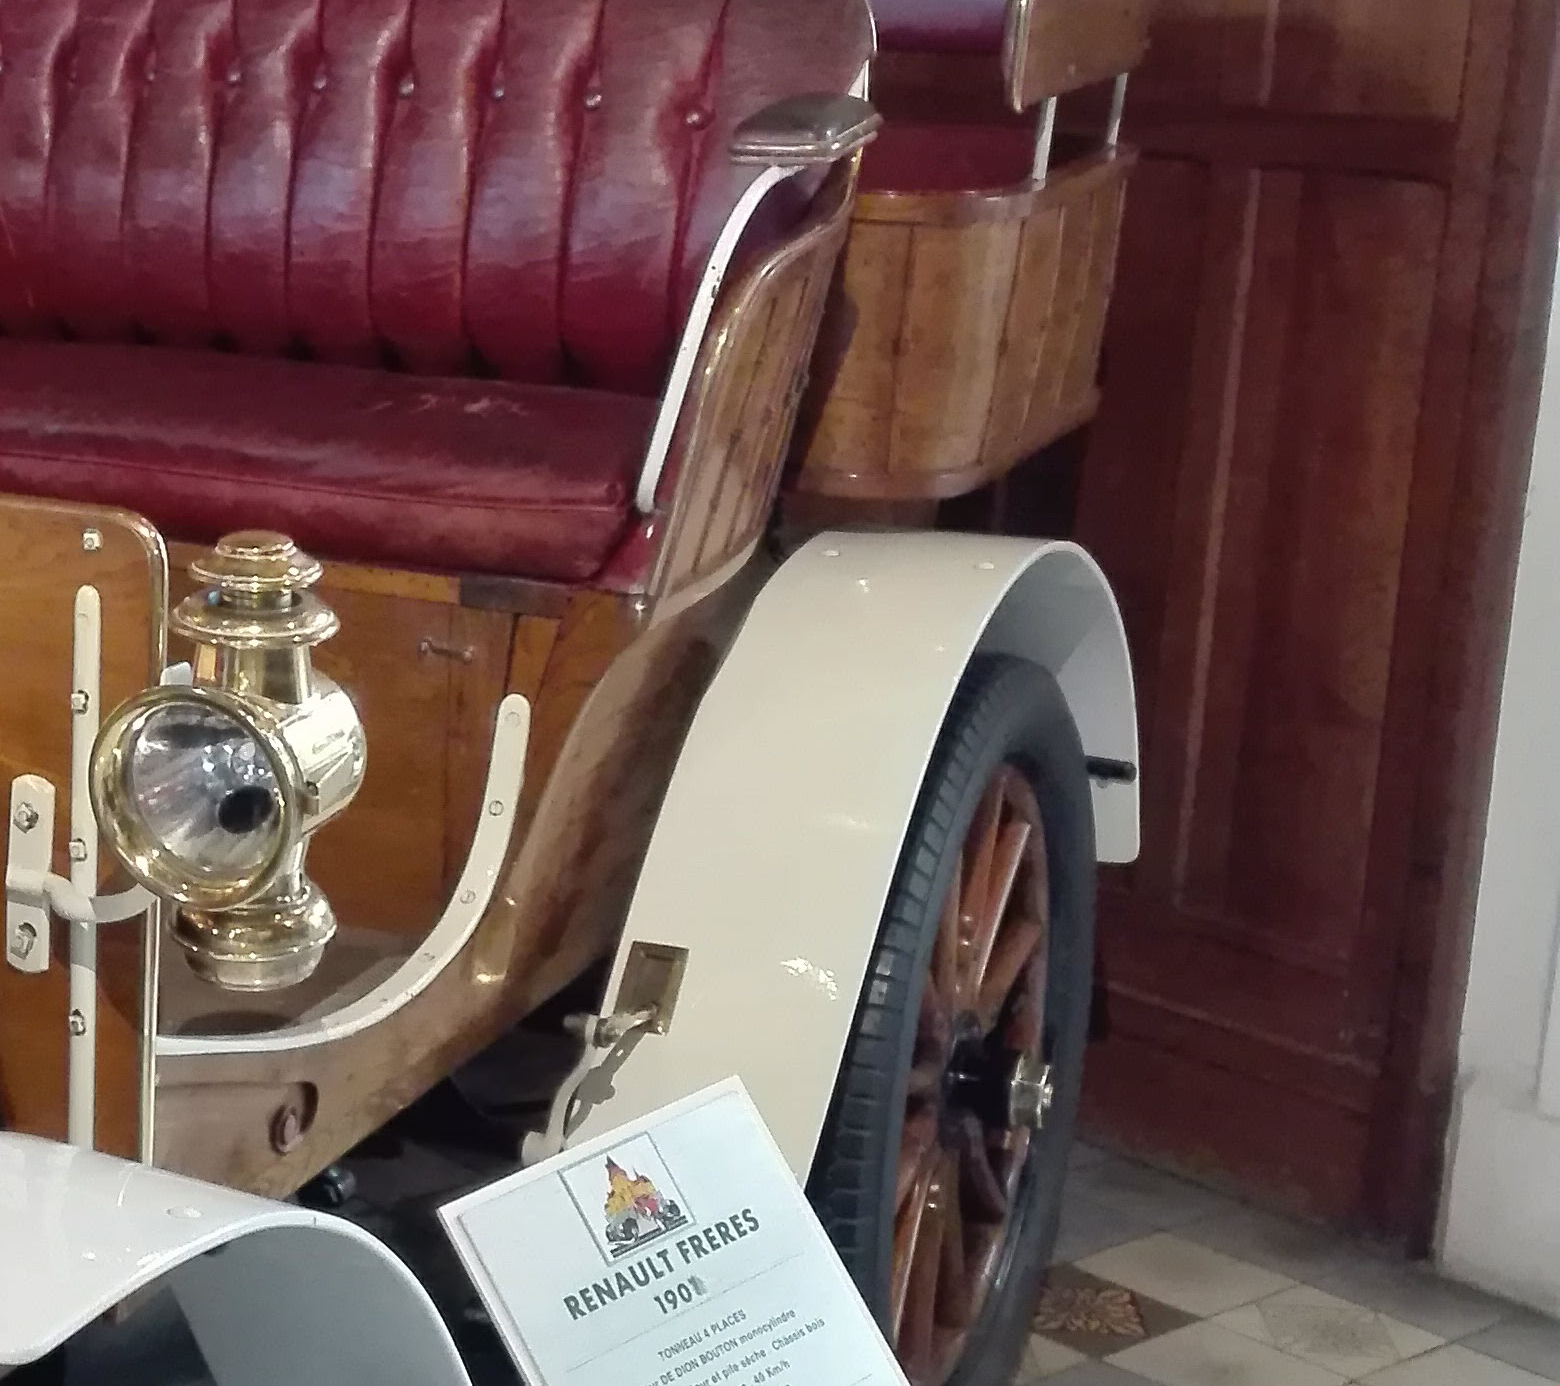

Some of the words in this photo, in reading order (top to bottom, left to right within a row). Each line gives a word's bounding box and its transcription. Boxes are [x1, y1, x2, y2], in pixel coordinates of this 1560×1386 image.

[561, 1247, 678, 1321] RENAULT
[674, 1206, 762, 1266] FRERES
[656, 1330, 704, 1362] TONNEAU
[709, 1308, 748, 1335] PLACES
[673, 1357, 700, 1378] DION
[698, 1337, 739, 1365] BOUTON
[736, 1306, 798, 1346] monocylindre
[719, 1360, 741, 1379] pile
[804, 1315, 826, 1333] bois
[764, 1357, 791, 1378] Km/h
